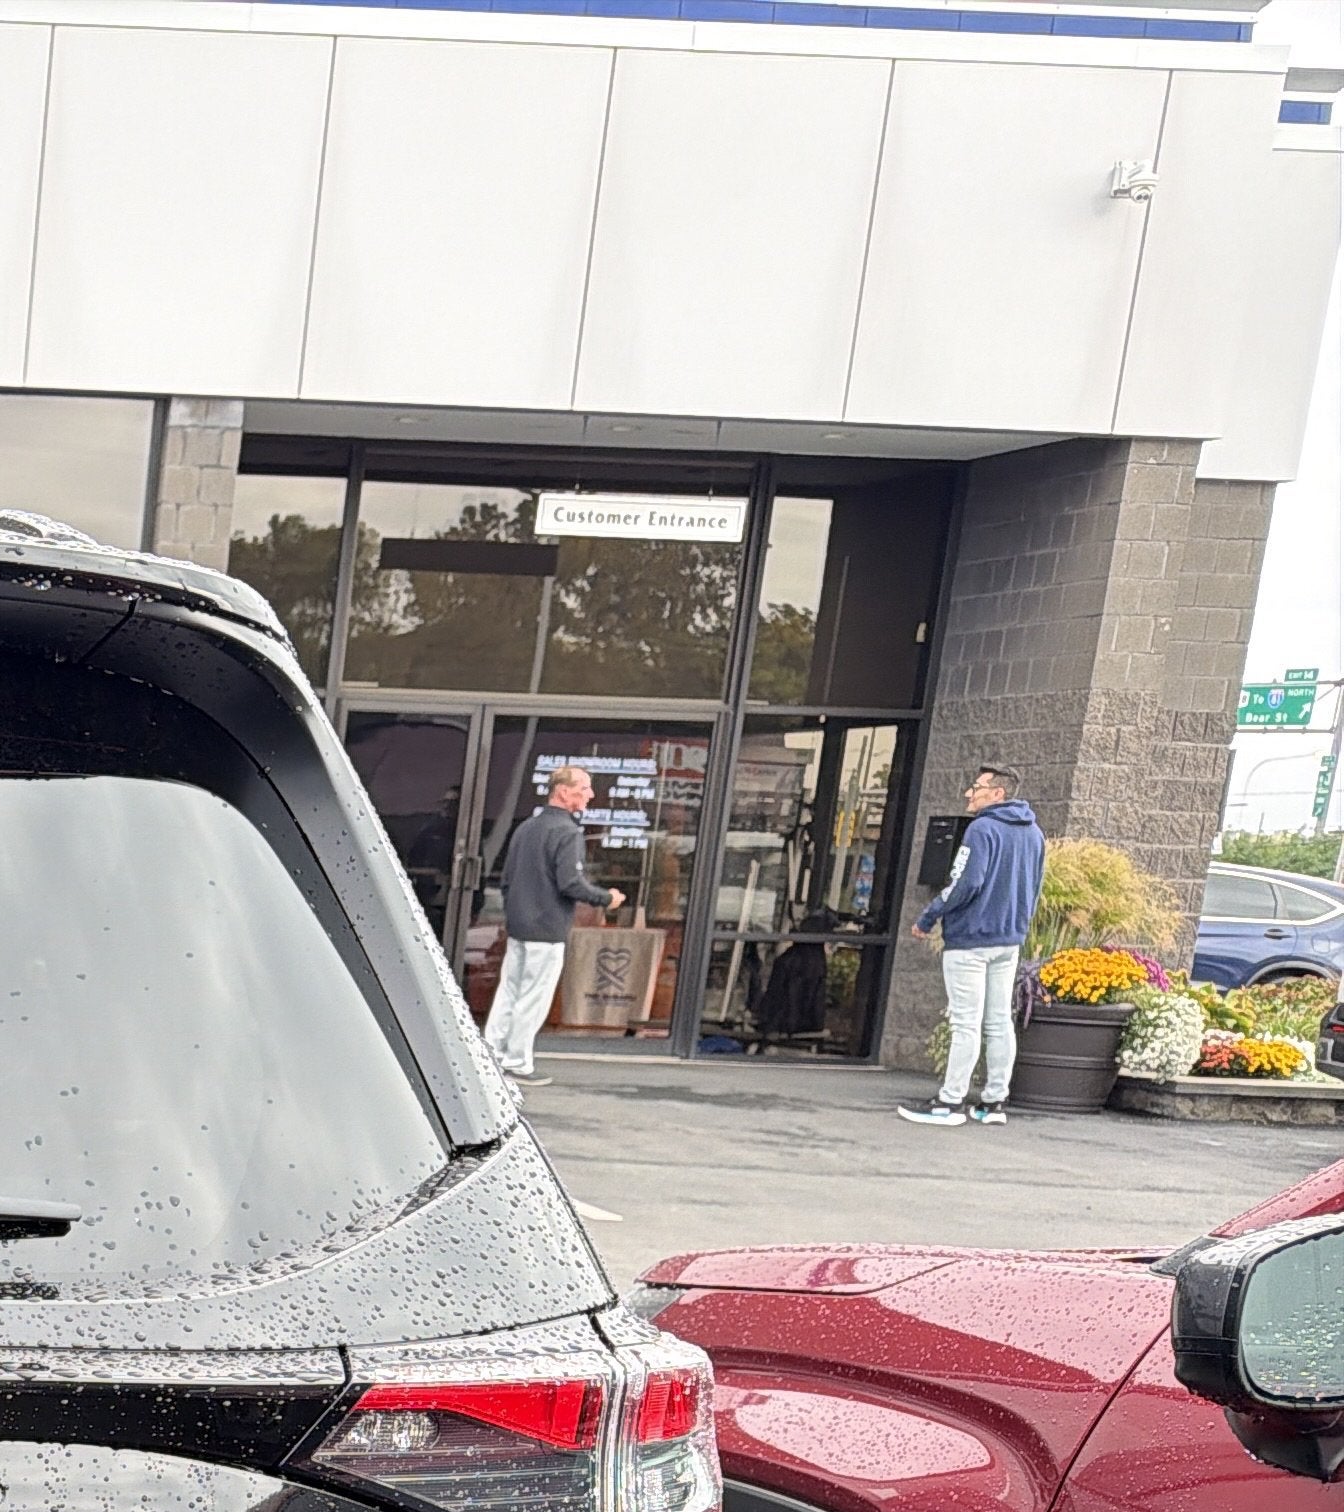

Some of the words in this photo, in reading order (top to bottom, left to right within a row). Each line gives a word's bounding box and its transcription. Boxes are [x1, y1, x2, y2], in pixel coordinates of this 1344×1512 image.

[553, 506, 641, 526] Customer
[648, 511, 728, 529] Entrance
[1288, 689, 1315, 697] NORTH
[1253, 693, 1265, 705] To
[1245, 712, 1271, 723] Bear
[1275, 712, 1288, 723] St
